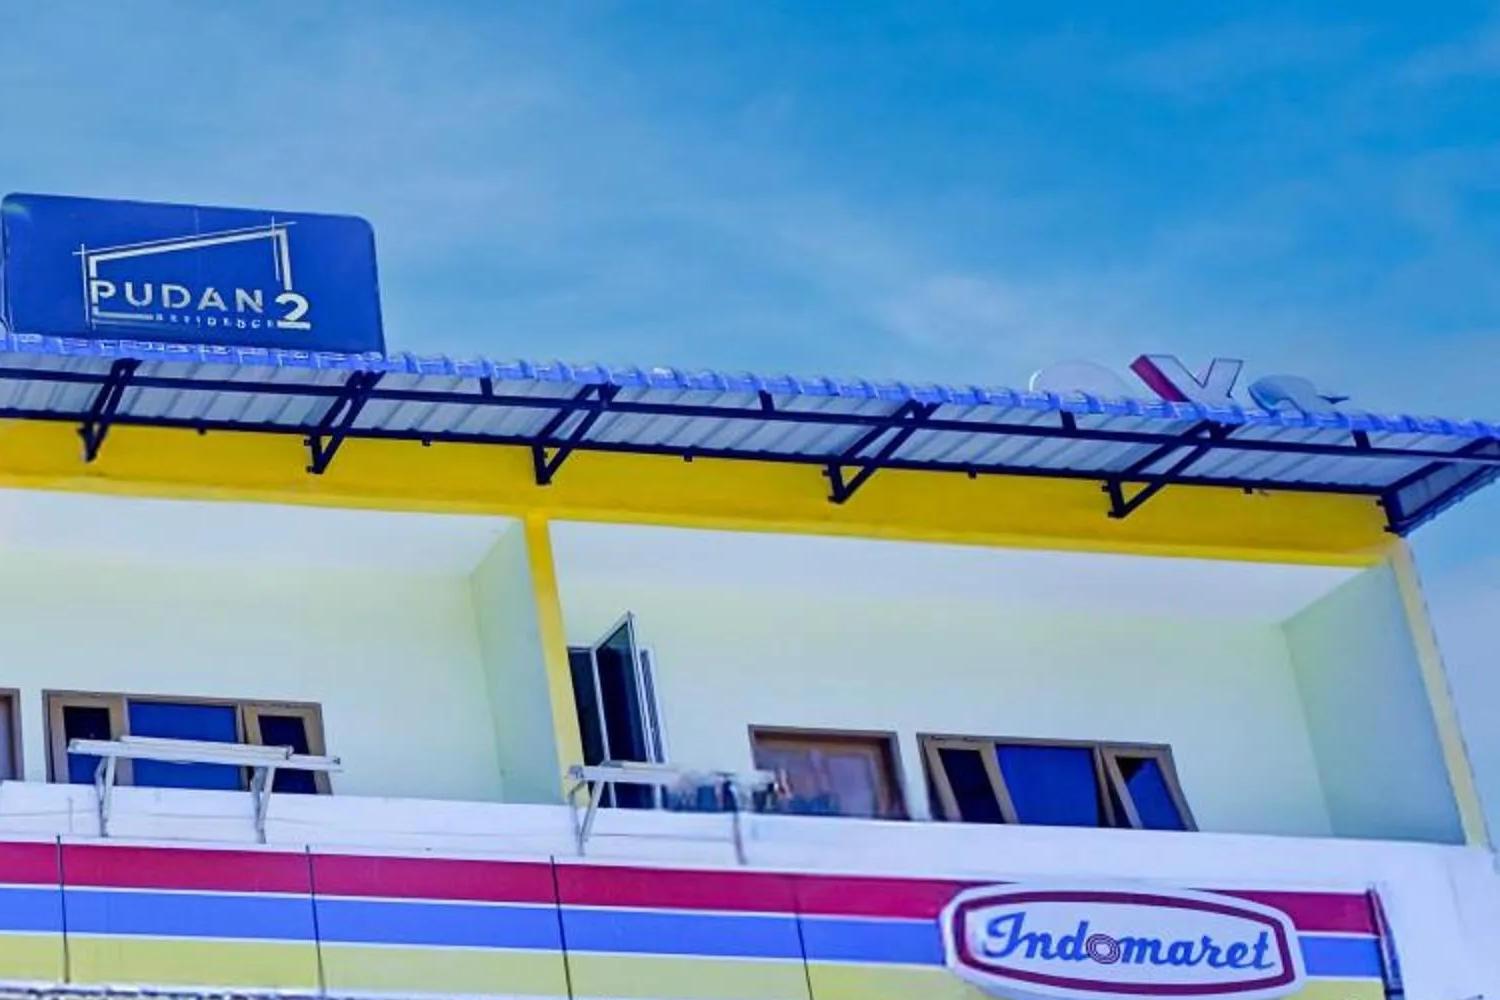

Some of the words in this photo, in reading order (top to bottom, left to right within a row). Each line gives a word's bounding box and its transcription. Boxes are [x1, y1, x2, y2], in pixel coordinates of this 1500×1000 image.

[90, 279, 263, 314] PUDAN
[275, 292, 311, 330] 2
[983, 911, 1275, 970] Indomaret
